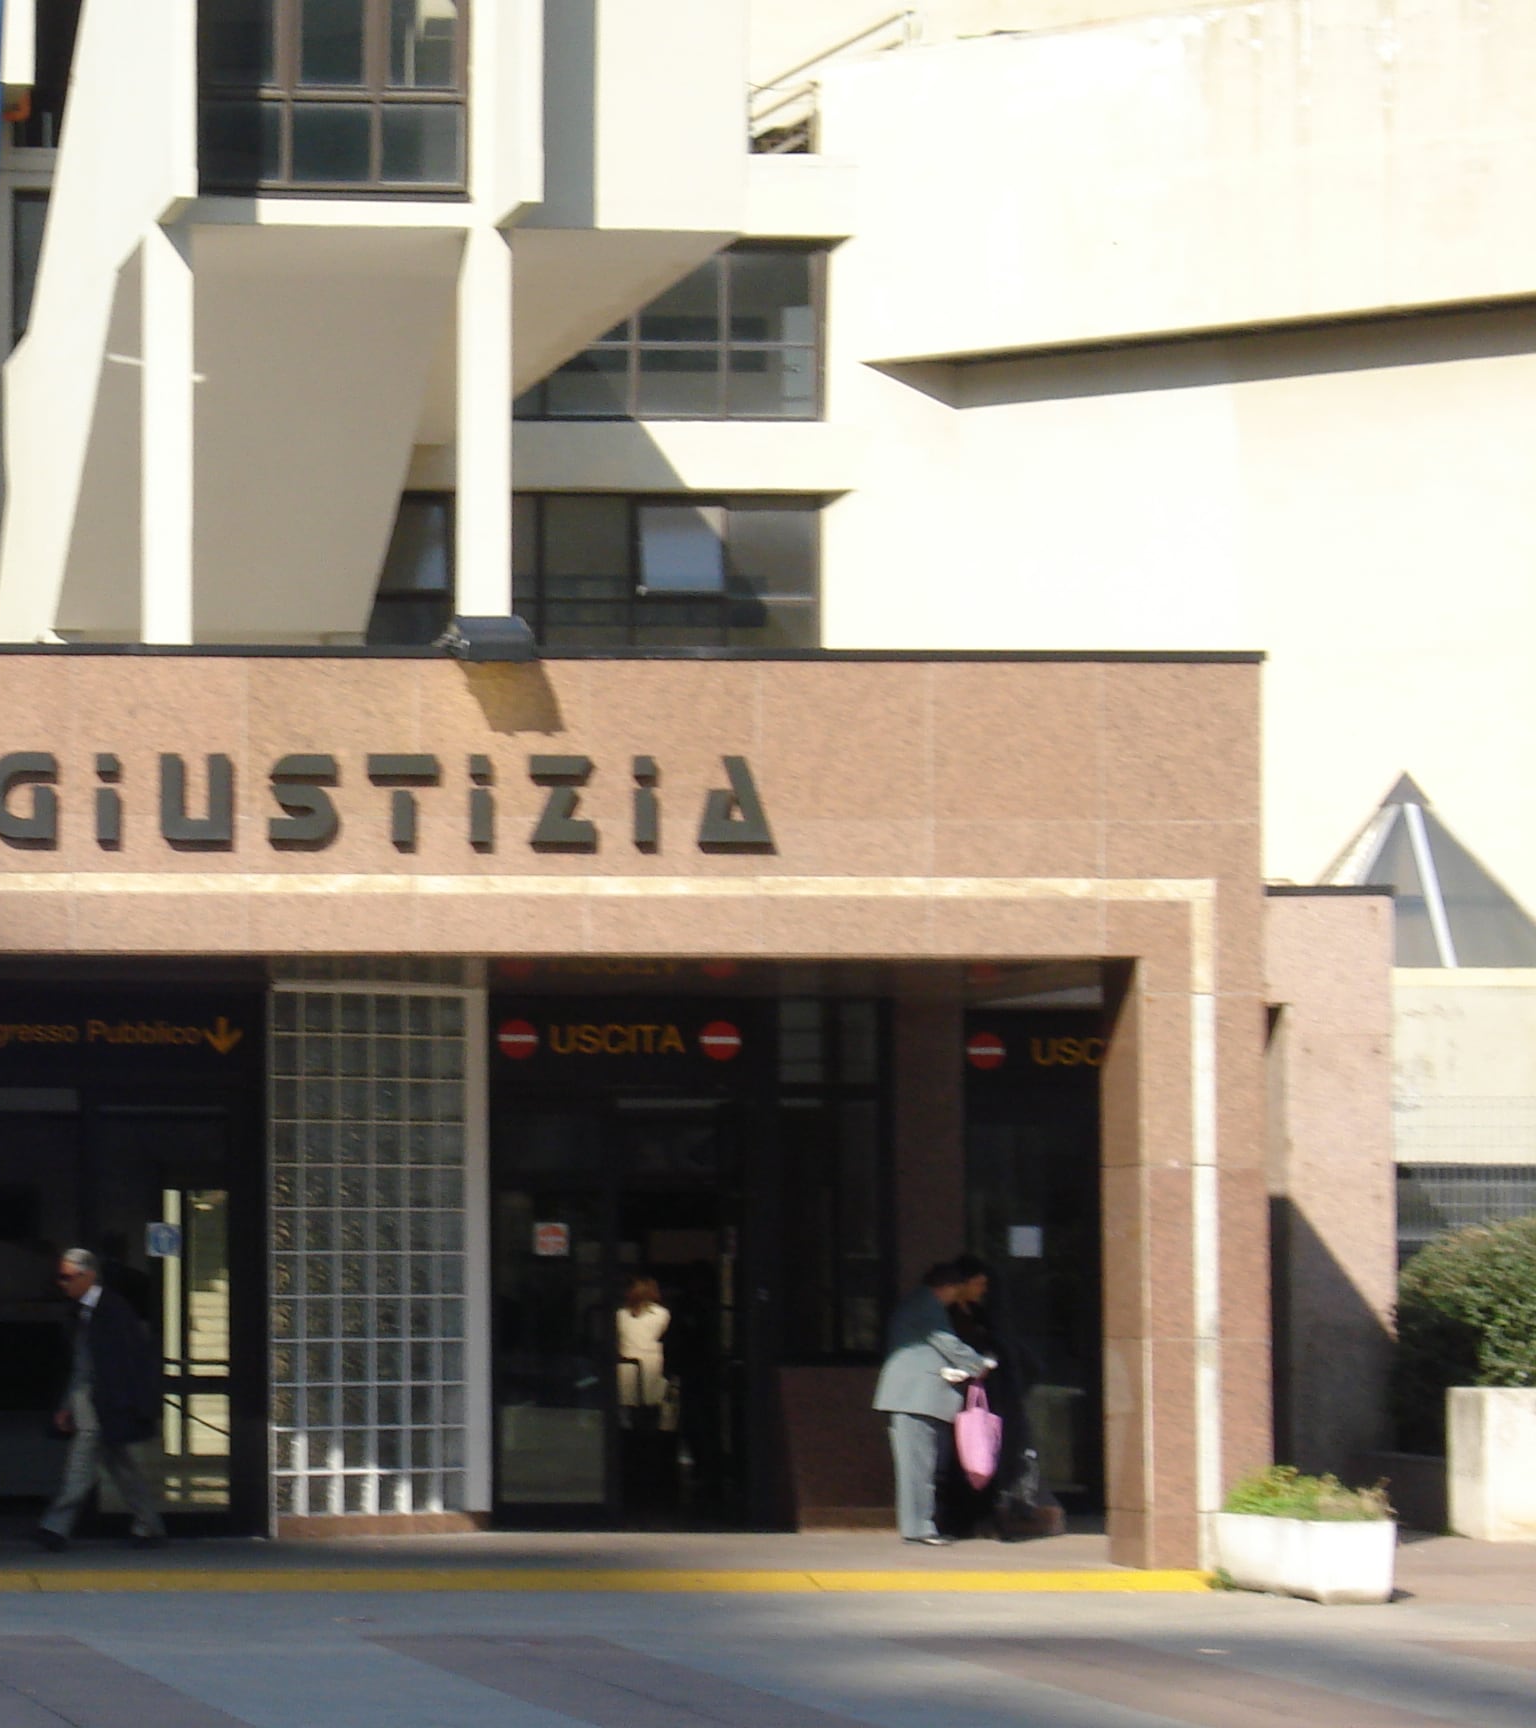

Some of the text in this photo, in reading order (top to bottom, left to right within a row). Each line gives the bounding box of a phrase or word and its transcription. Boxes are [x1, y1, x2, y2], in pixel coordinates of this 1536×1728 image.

[85, 1018, 202, 1045] Pubblico
[548, 1024, 686, 1055] USCITA
[1029, 1037, 1107, 1067] USC
